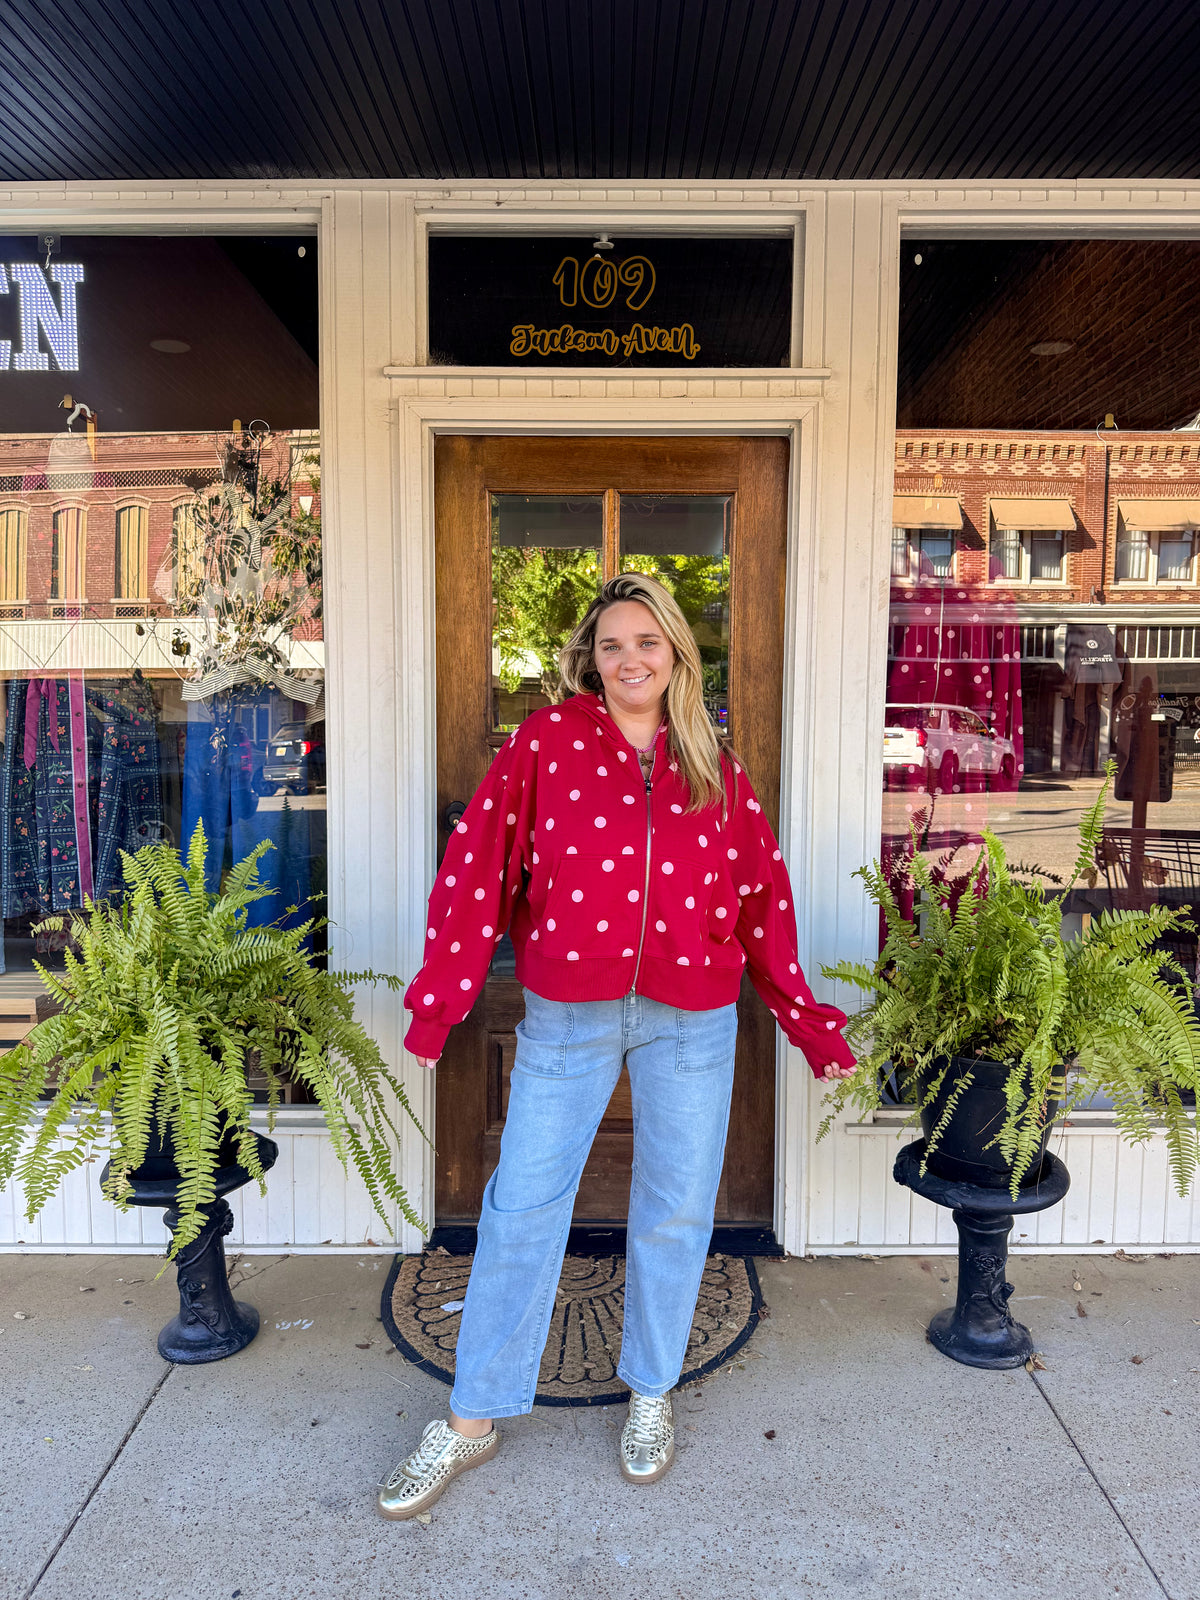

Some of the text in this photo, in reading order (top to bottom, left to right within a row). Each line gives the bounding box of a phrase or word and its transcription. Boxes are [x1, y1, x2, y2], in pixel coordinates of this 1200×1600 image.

[552, 255, 656, 311] 109
[0, 263, 84, 371] N
[510, 323, 619, 356] Jackson
